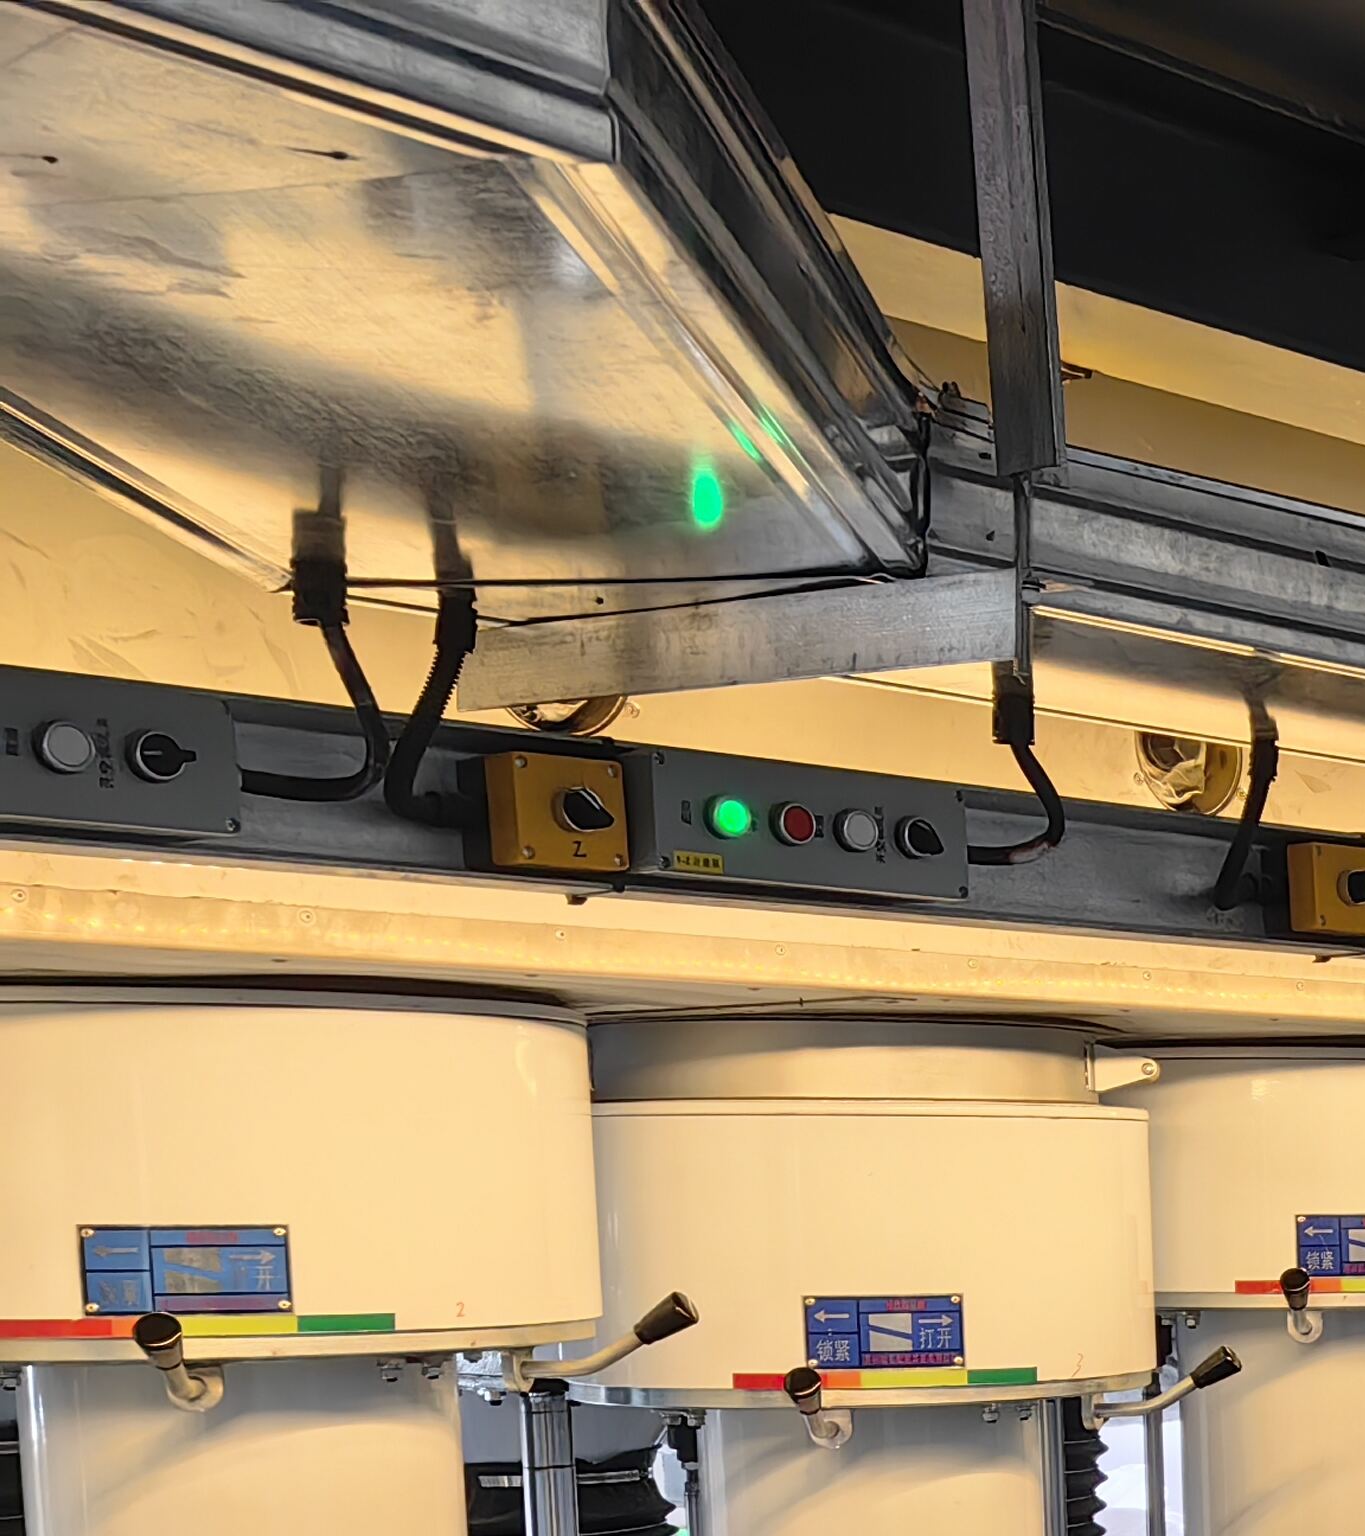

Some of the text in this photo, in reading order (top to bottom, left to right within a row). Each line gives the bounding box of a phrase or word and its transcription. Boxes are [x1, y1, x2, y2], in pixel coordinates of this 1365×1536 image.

[456, 1301, 466, 1317] 2
[919, 1327, 952, 1350] 打开
[816, 1339, 851, 1362] 锁紧
